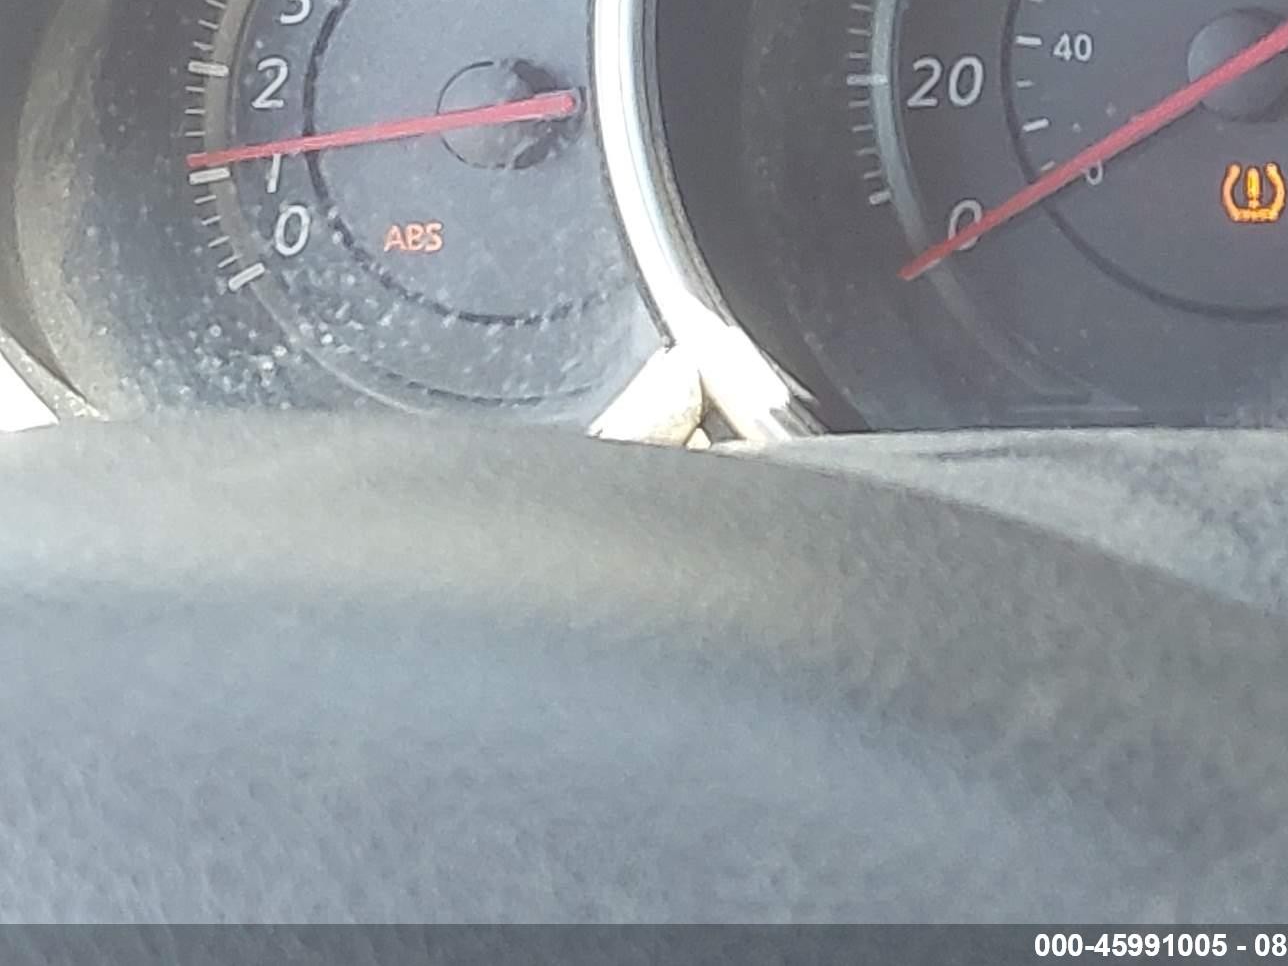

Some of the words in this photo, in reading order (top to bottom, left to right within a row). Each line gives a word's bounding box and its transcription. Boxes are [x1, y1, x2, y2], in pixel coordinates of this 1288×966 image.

[1053, 33, 1092, 63] 40
[250, 57, 290, 111] 2
[906, 57, 985, 107] 20
[273, 203, 311, 256] 0
[383, 222, 443, 253] ABS
